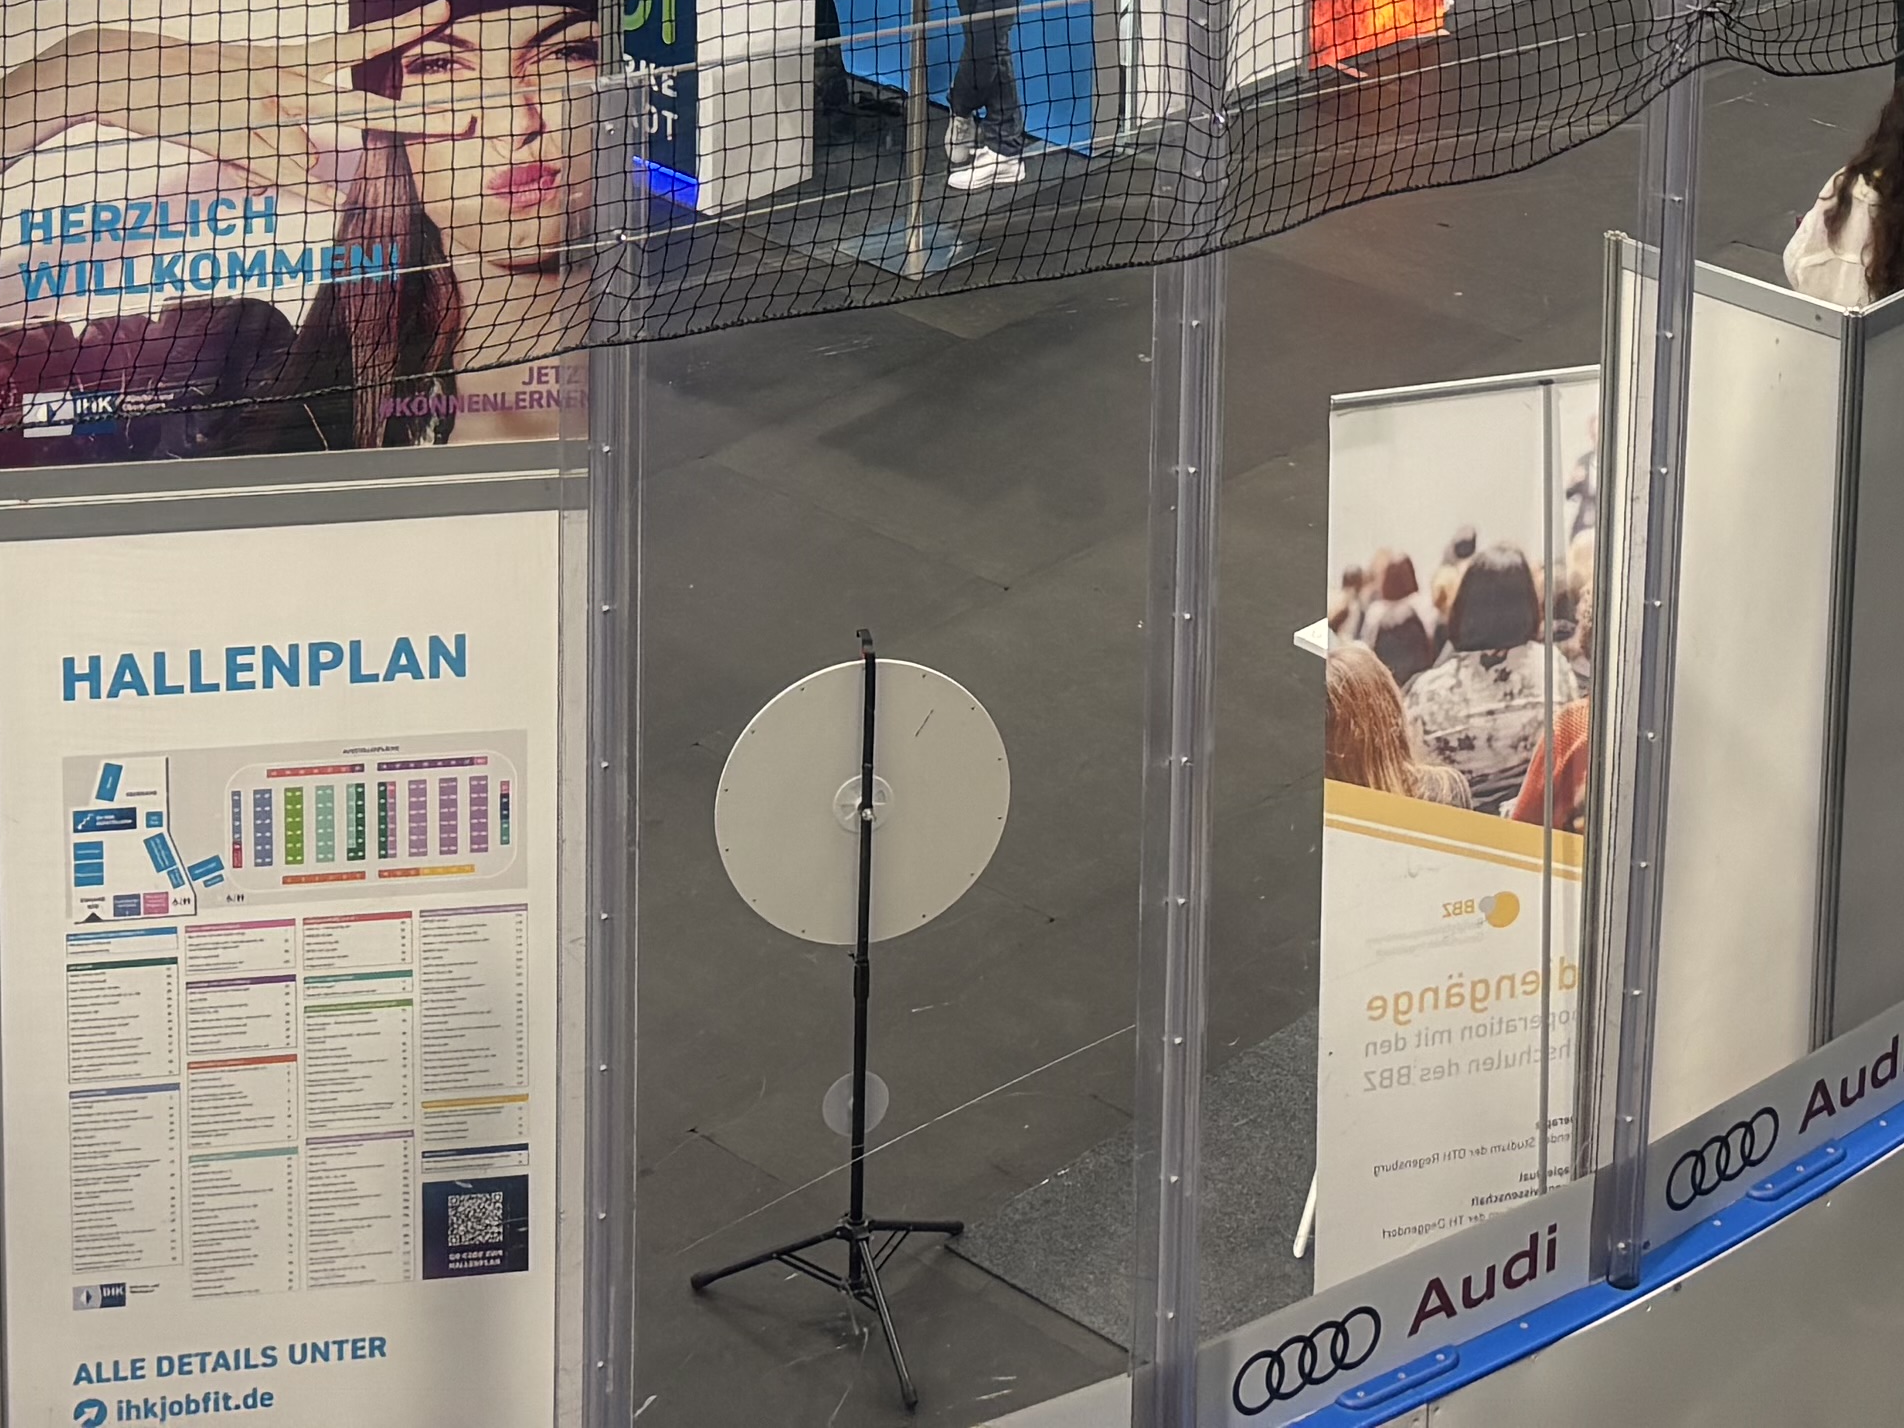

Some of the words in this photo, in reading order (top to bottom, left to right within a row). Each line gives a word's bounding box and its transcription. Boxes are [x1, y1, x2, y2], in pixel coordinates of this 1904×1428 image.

[18, 195, 276, 246] HERZLICH
[18, 243, 399, 303] WILLKOMMEN!
[62, 633, 468, 702] HALLENPLAN
[102, 1284, 125, 1298] IHK
[1407, 1222, 1559, 1339] Audi
[72, 1357, 147, 1387] ALLE
[156, 1346, 278, 1379] DETAILS
[288, 1336, 388, 1366] UNTER
[116, 1387, 275, 1422] ihkjobfit.de
